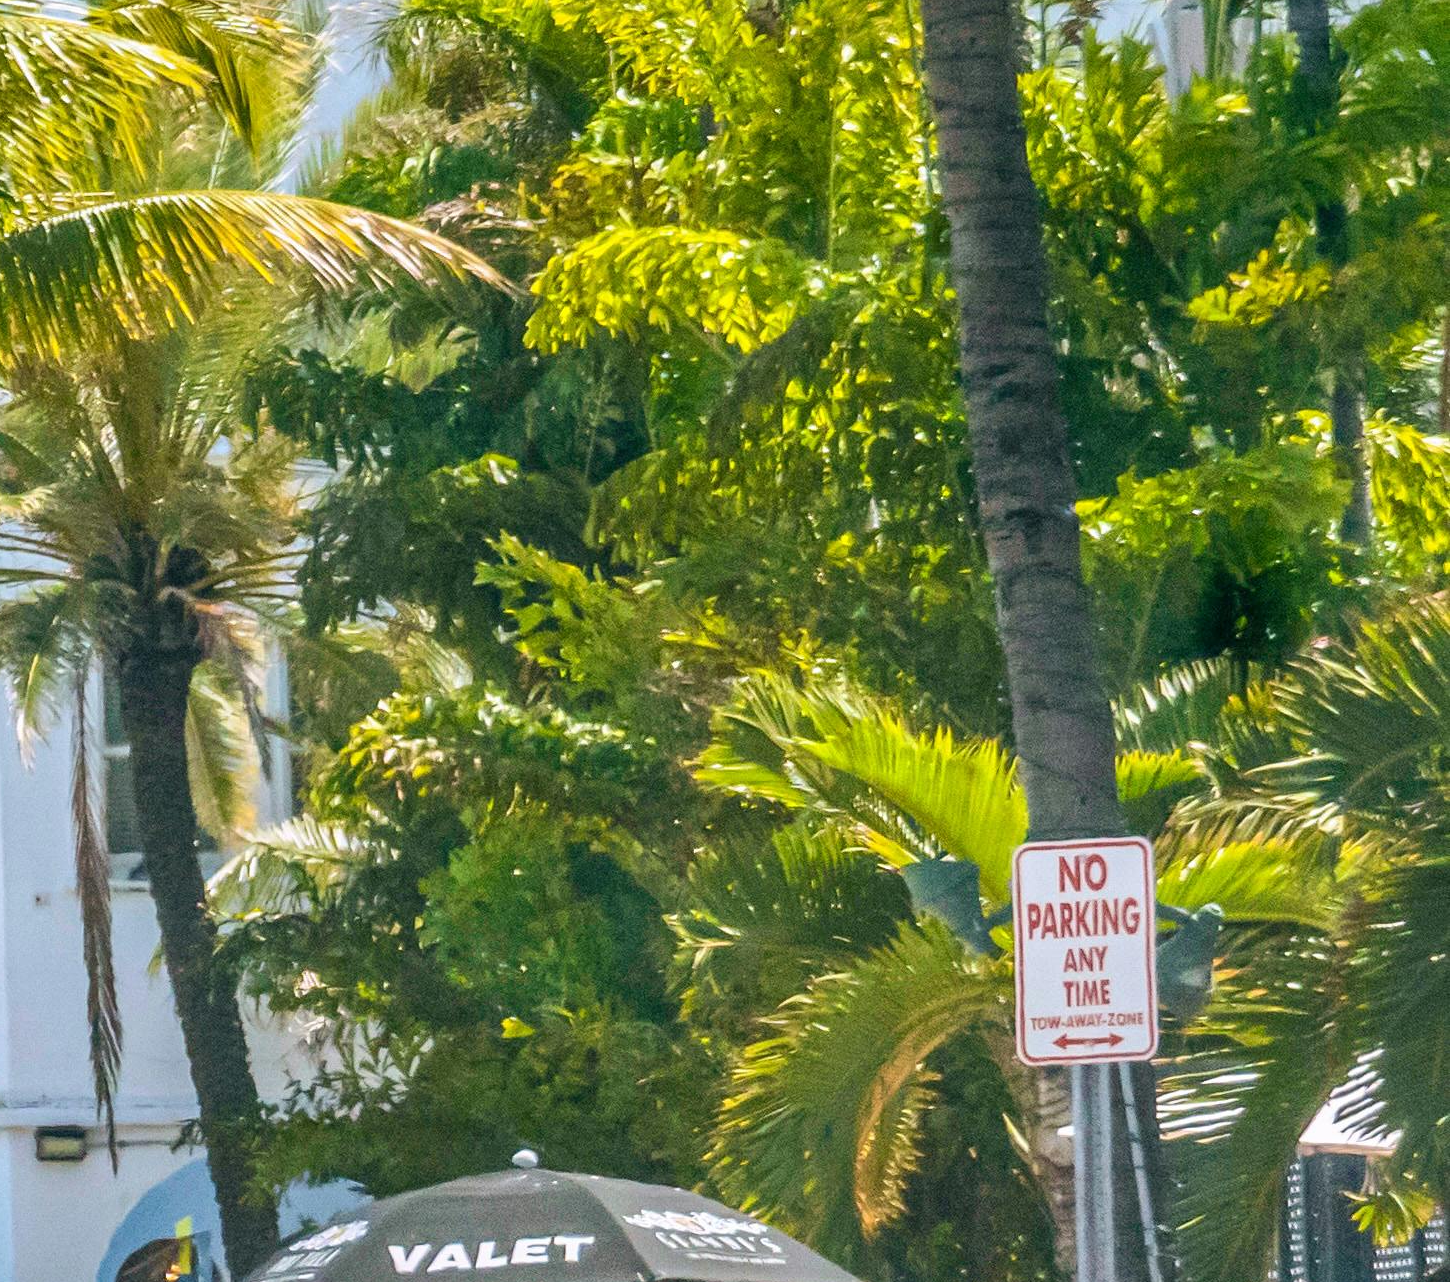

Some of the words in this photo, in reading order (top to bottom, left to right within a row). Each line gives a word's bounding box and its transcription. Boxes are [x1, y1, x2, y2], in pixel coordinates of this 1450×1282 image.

[1058, 853, 1108, 893] NO
[1026, 897, 1141, 940] PARKING
[1063, 946, 1108, 973] ANY
[1062, 979, 1111, 1007] TIME
[1030, 1012, 1144, 1031] TOW-AWAY-ZONE
[388, 1235, 595, 1274] VALET
